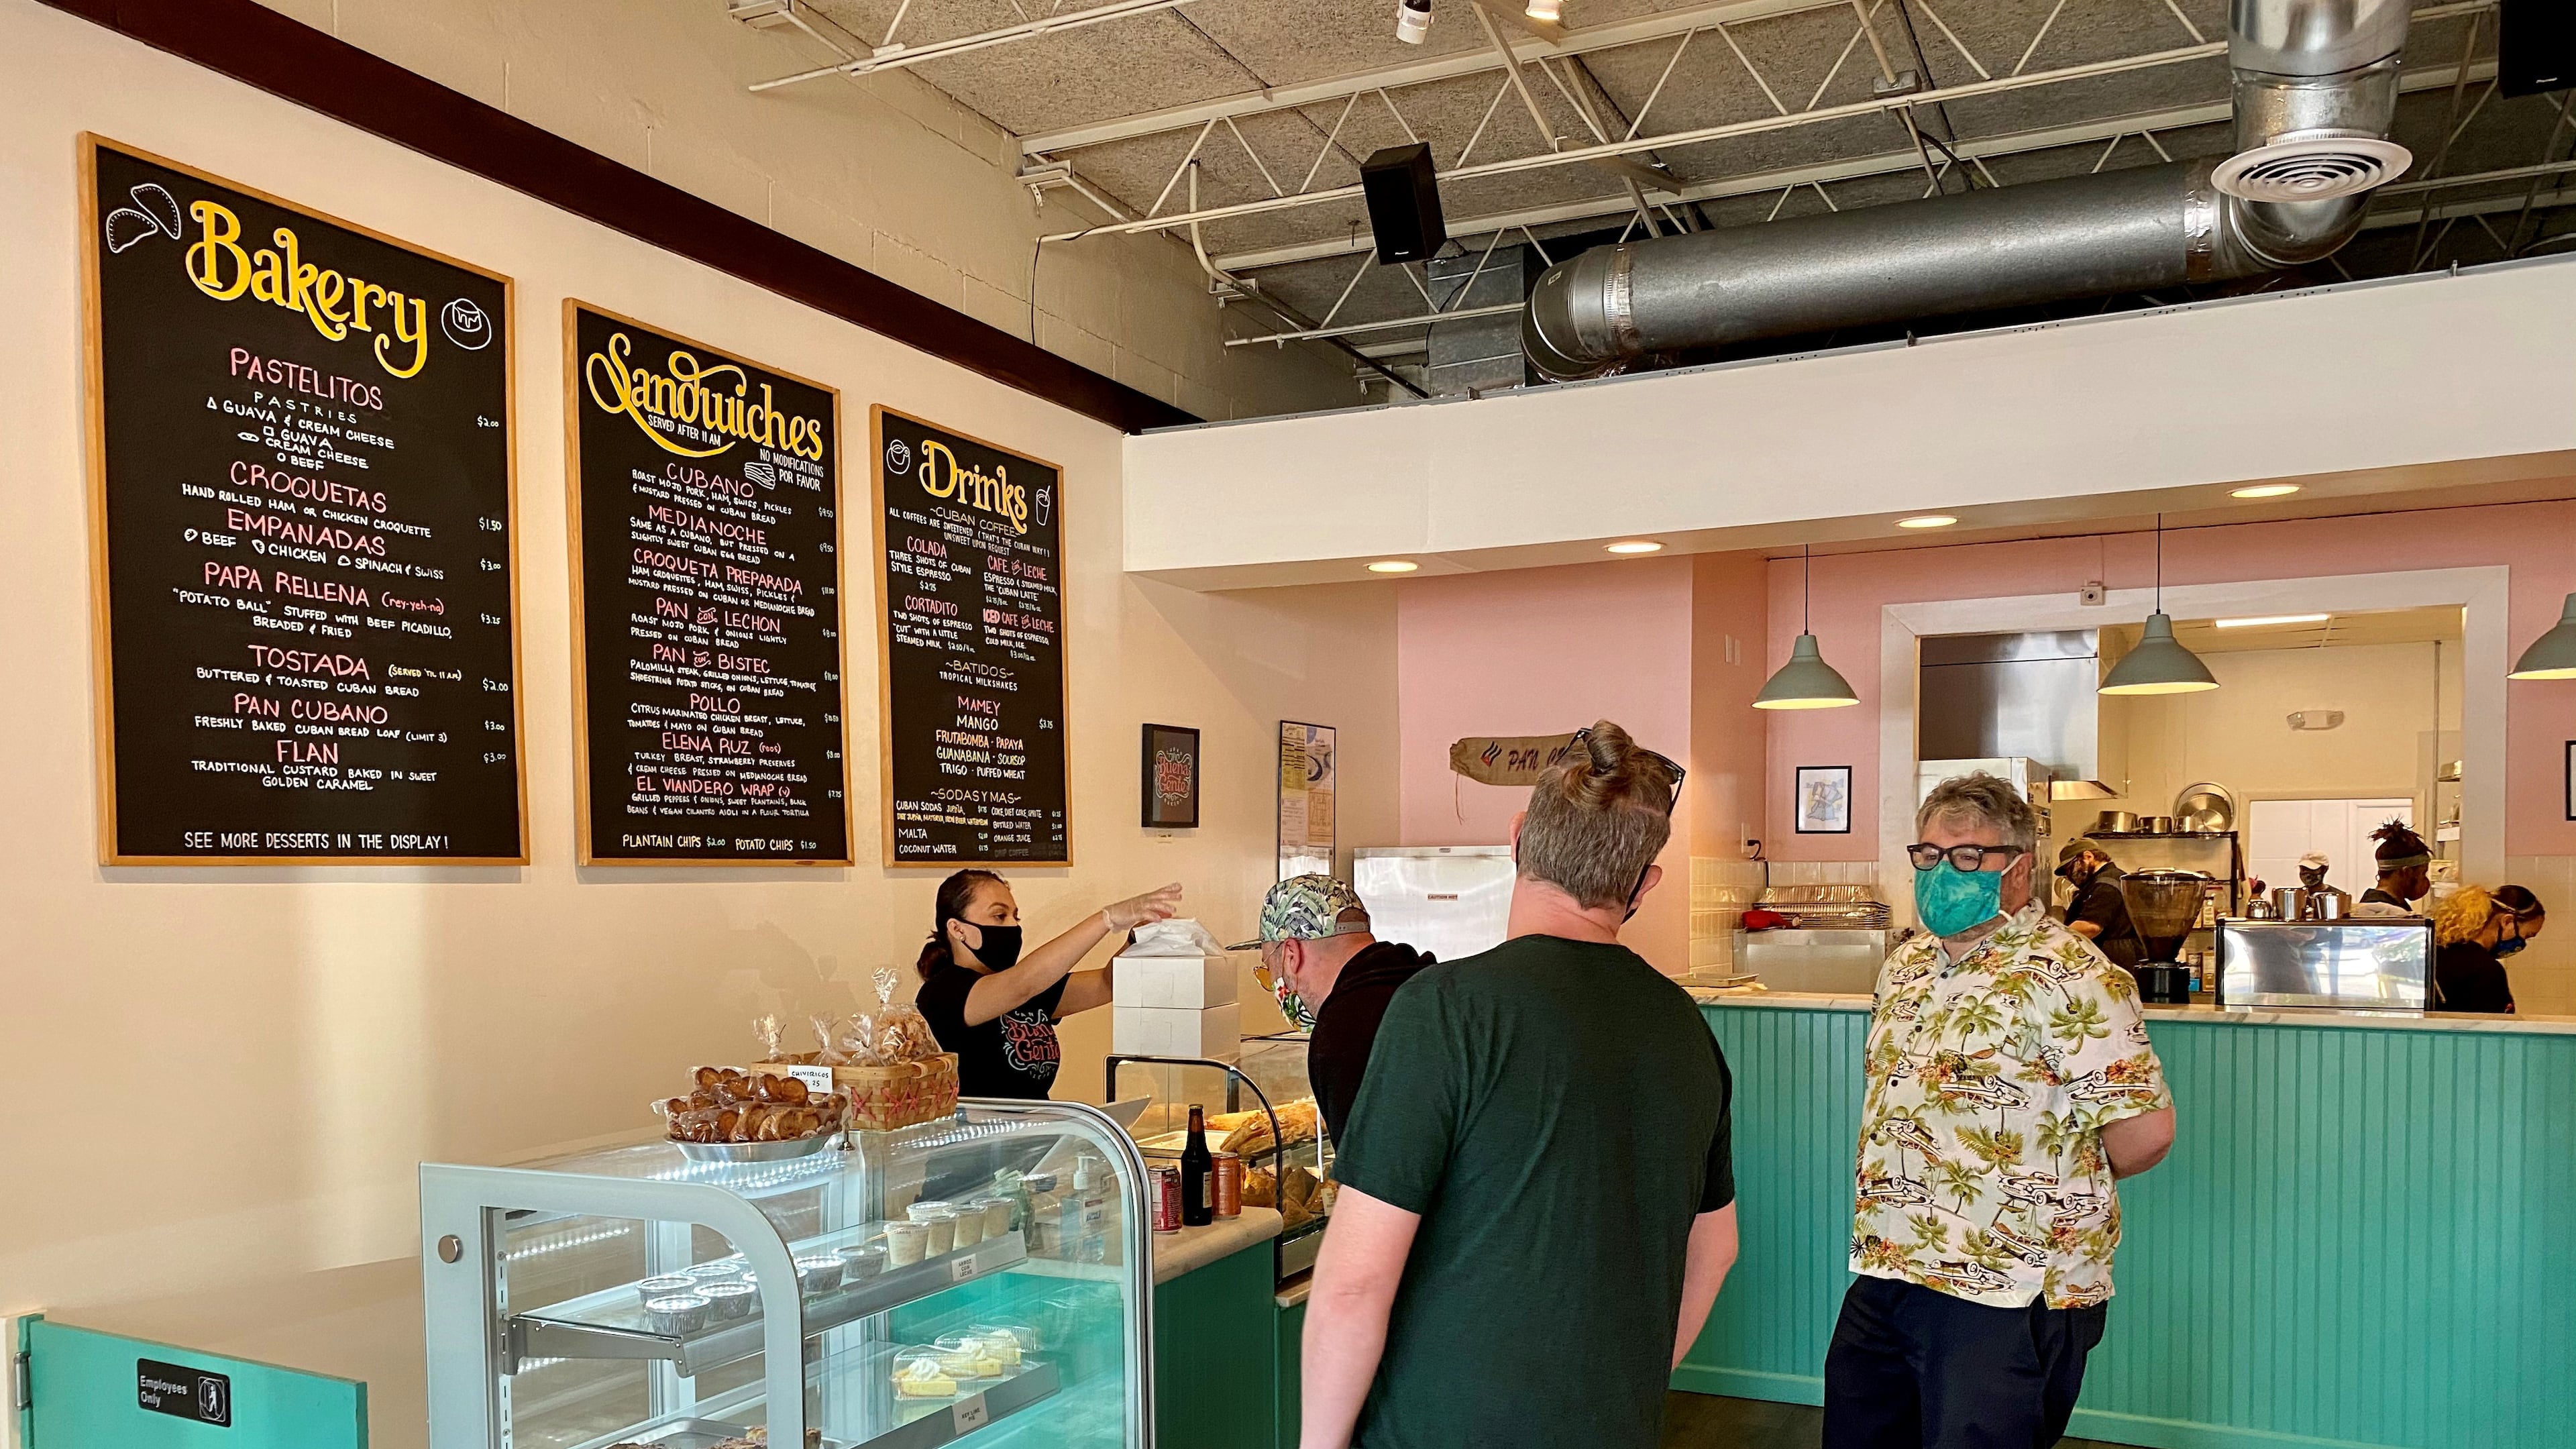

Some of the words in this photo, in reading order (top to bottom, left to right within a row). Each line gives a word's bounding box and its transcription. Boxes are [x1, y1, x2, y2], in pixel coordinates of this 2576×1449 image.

[186, 200, 427, 378] Bakery
[231, 348, 382, 410] PASTELITOS
[254, 392, 357, 423] PASTRIES
[586, 333, 823, 460] Sandwiches
[223, 400, 276, 423] GUAVA
[299, 419, 339, 437] CREAM
[346, 430, 394, 449] CHEESE
[477, 415, 499, 427] $2.00
[648, 415, 675, 432] SERVED
[678, 423, 698, 440] AFTER
[709, 433, 720, 447] AM
[281, 429, 333, 451] GUAVA
[266, 437, 311, 455] CREAM
[318, 449, 369, 469] CHEESE
[291, 455, 324, 470] BEEF
[759, 449, 770, 462] NO
[773, 451, 824, 478] MODIFICATIONS
[231, 461, 386, 513] CROQUETAS
[666, 462, 753, 498] CUBANO
[779, 468, 793, 484] POR
[797, 474, 820, 492] FAVOR
[919, 439, 1028, 534] Drinks
[182, 483, 215, 498] HAND
[219, 490, 262, 507] ROLLED
[268, 499, 296, 513] HAM
[303, 507, 317, 517] OR
[323, 509, 368, 526] CHICKEN
[374, 519, 431, 537] CROQUETTE
[228, 508, 386, 557] EMPANADAS
[479, 517, 502, 531] $1.50
[649, 505, 767, 545] MEDIANOCHE
[202, 531, 236, 547] BEEF
[268, 543, 327, 564] CHICKEN
[355, 557, 402, 574] SPINACH
[415, 567, 443, 580] SWISS
[907, 536, 947, 559] COLADA
[480, 558, 501, 570] $3.00
[633, 548, 718, 578] CROQUETA
[725, 566, 803, 596] PREPARADA
[889, 550, 912, 563] THREE
[916, 555, 936, 567] SHOTS
[938, 560, 947, 569] OF
[951, 564, 971, 575] CUBAN
[891, 561, 913, 574] STYLE
[987, 555, 1009, 573] CAFE
[1023, 563, 1047, 580] LECHE
[205, 561, 263, 592] PAPA
[276, 572, 370, 608] RELLENA
[382, 592, 444, 615] (rey-yeh-na)
[172, 588, 230, 607] "POTATO
[284, 606, 327, 621] STUFFED
[335, 614, 359, 625] WITH
[367, 617, 395, 629] BEEF
[402, 621, 452, 639] PICADILLO,
[656, 597, 688, 620] PAN
[725, 610, 780, 633] LECHON
[905, 595, 958, 616] CORTADITO
[253, 616, 304, 632] BREADED
[321, 625, 352, 638] FRIED
[481, 613, 500, 625] $3.25
[248, 644, 370, 680] TOSTADA
[388, 663, 421, 678] (SERVED
[653, 643, 685, 663] PAN
[718, 653, 770, 674] BISTEC
[196, 667, 260, 684] BUTTERED
[276, 676, 328, 690] TOASTED
[337, 682, 376, 695] CUBAN
[385, 686, 419, 697] BREAD
[482, 678, 508, 692] $2.00
[940, 671, 973, 684] TROPICAL
[975, 677, 1018, 692] MILKSHAKES
[234, 693, 280, 718] PAN
[291, 699, 388, 724] CUBANO
[690, 693, 740, 713] POLLO
[958, 696, 1001, 716] MAMEY
[195, 716, 244, 729] FRESHLY
[252, 720, 286, 733] BAKED
[295, 724, 333, 735] CUBAN
[338, 727, 370, 737] BREAD
[377, 729, 400, 739] LOAF
[406, 731, 435, 742] (LIMIT
[438, 733, 447, 743] 3)
[484, 720, 505, 731] $3.00
[957, 714, 998, 731] MANGO
[662, 732, 713, 753] ELENA
[719, 738, 751, 755] RUZ
[936, 729, 989, 749] FRUTABOMBA
[996, 736, 1023, 751] PAPAYA
[277, 740, 338, 764] FLAN
[484, 753, 506, 763] $3.00
[936, 747, 990, 763] GUANABANA
[997, 753, 1026, 766] SOURSOP
[1508, 749, 1539, 771] PAN
[191, 760, 275, 774] TRADITIONAL
[283, 765, 337, 777] CUSTARD
[348, 768, 382, 780] BAKED
[390, 770, 402, 780] IN
[408, 772, 437, 782] SWEET
[939, 763, 967, 776] TRIGO
[977, 767, 1002, 779] PUFFED
[1004, 769, 1025, 780] WHEAT
[1159, 756, 1189, 776] Buena
[262, 776, 309, 788] GOLDEN
[316, 779, 374, 790] CARAMEL
[637, 775, 656, 792] EL
[662, 778, 733, 795] VIANDERO
[741, 784, 775, 797] WRAP
[1159, 773, 1186, 792] Gente
[896, 800, 918, 811] CUBAN
[921, 802, 942, 812] SODAS
[981, 791, 988, 802] Y
[184, 832, 213, 849] SEE
[221, 832, 258, 849] MORE
[266, 833, 329, 849] DESSERTS
[337, 833, 352, 849] IN
[358, 834, 382, 849] THE
[390, 834, 448, 849] DISPLAY!
[623, 834, 672, 848] PLANTAIN
[678, 836, 701, 847] CHIPS
[706, 838, 726, 847] $2.00
[735, 839, 765, 850] POTATO
[770, 839, 793, 851] CHIPS
[800, 841, 816, 850] $1.50
[899, 828, 927, 839] MALTA
[900, 845, 930, 854] COCONUT
[932, 845, 957, 854] WATER
[792, 1071, 828, 1079] CHIVIRICOS
[140, 1375, 188, 1395] Employees
[140, 1391, 161, 1408] Only
